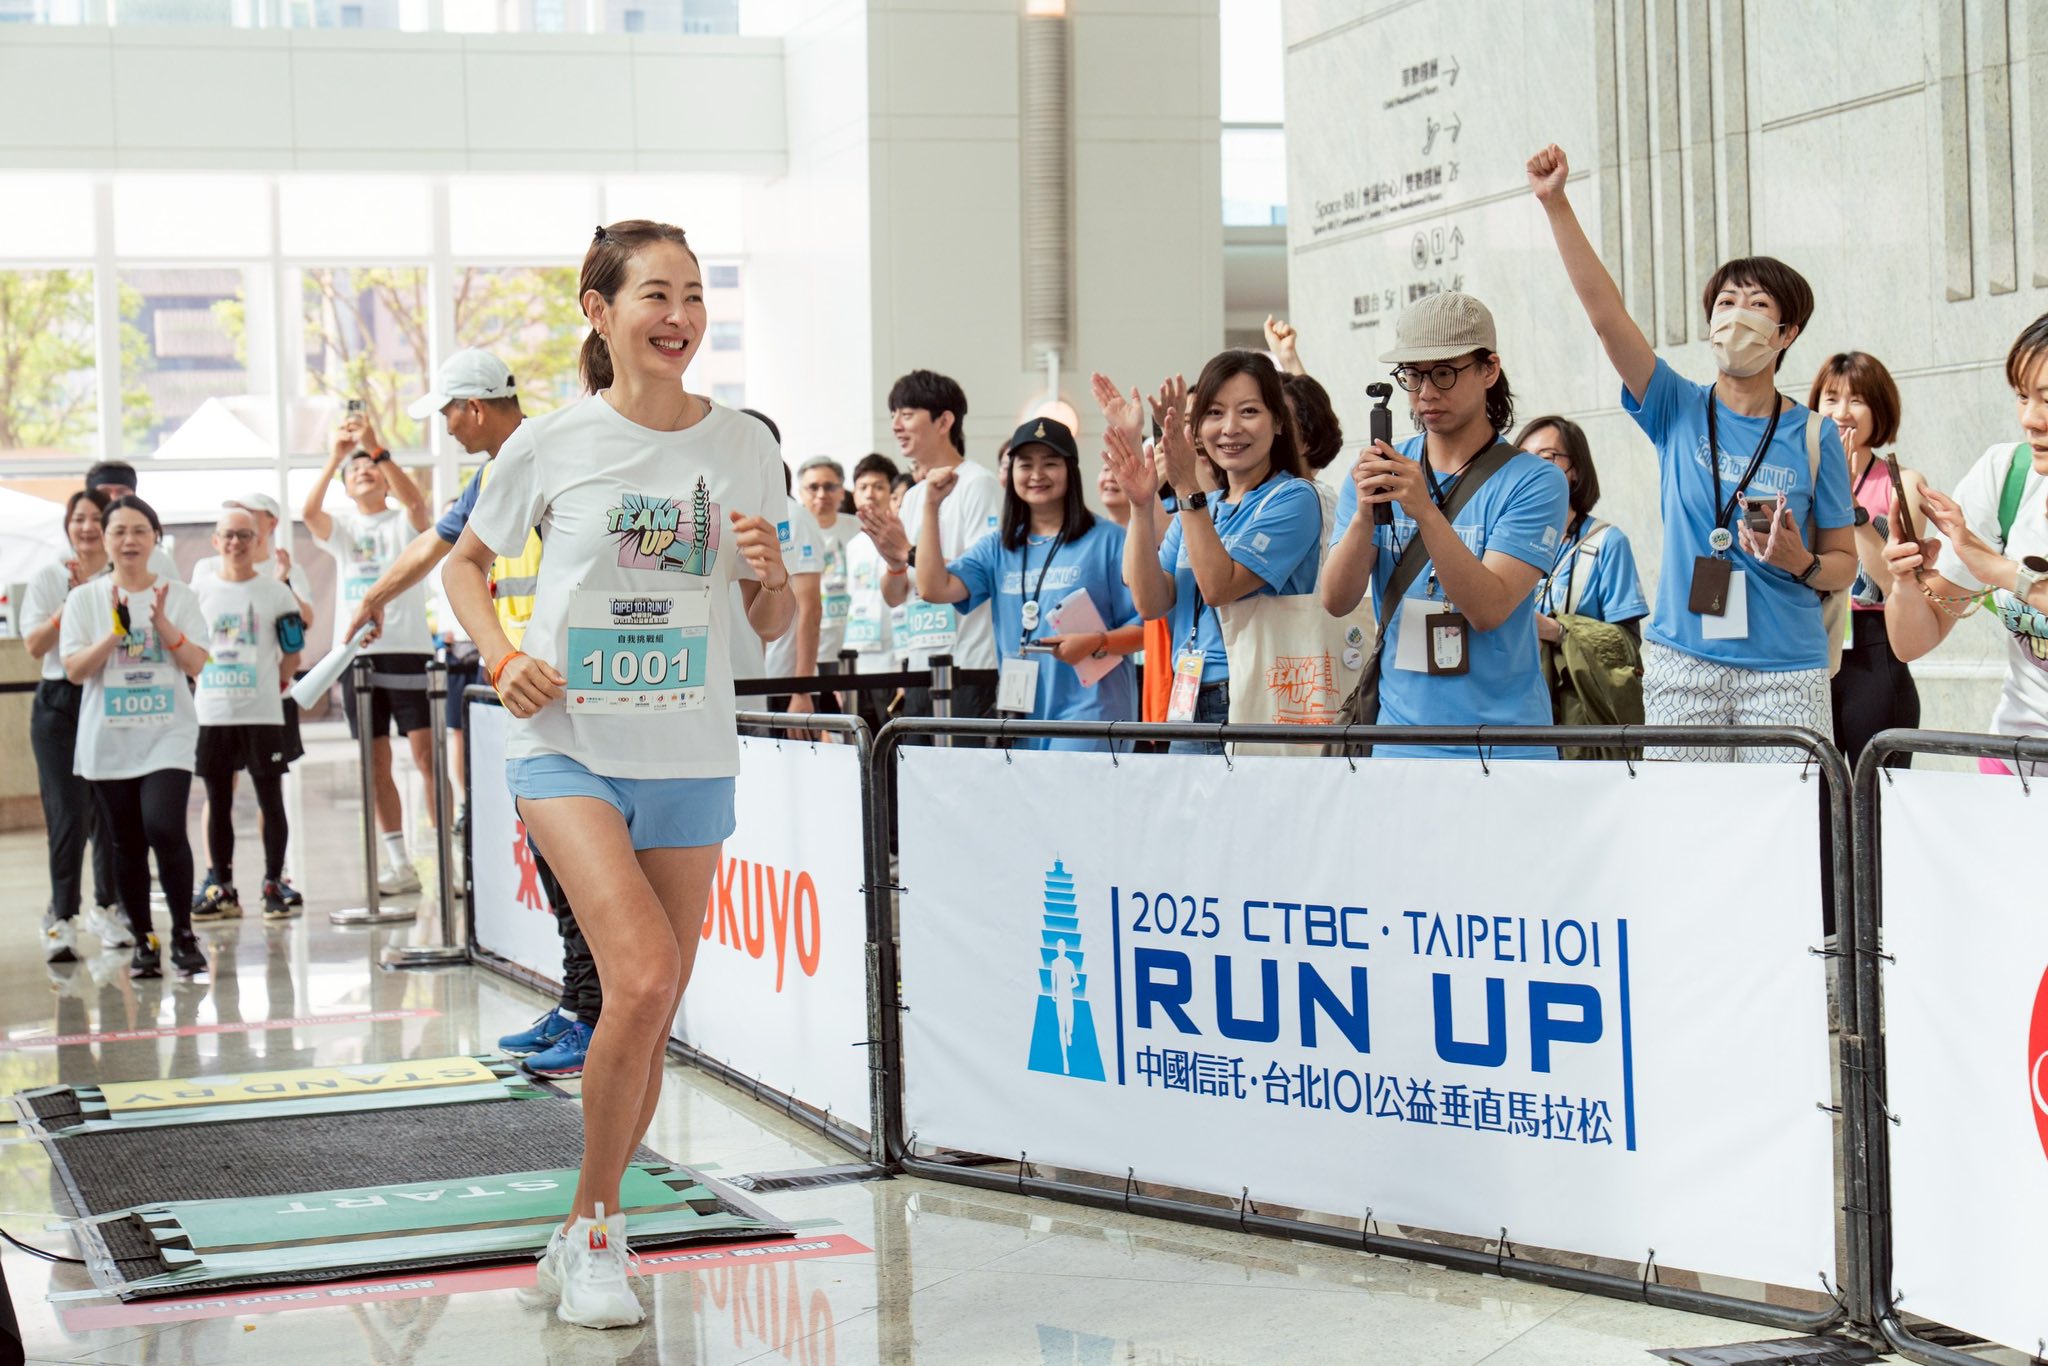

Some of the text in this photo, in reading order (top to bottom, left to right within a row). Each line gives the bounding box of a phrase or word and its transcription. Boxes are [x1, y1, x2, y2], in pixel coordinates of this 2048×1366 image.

[607, 507, 681, 533] TEAM
[640, 530, 676, 556] UP
[609, 597, 674, 614] TAIPEI 101 RUN UP
[909, 610, 948, 632] 025
[617, 634, 664, 644] 自我挑戰組
[205, 670, 250, 686] 1006
[582, 648, 689, 686] 1001
[111, 694, 168, 714] 1003
[1132, 891, 1221, 939] 2025
[1243, 900, 1370, 951] CTBC
[1403, 911, 1527, 963] TAIPEI
[1134, 947, 1604, 1074] RUN UP
[244, 1067, 477, 1093] STAND
[276, 1179, 559, 1214] START
[642, 1252, 724, 1266] Start
[150, 1300, 226, 1313] Line
[235, 1291, 318, 1306] Start
